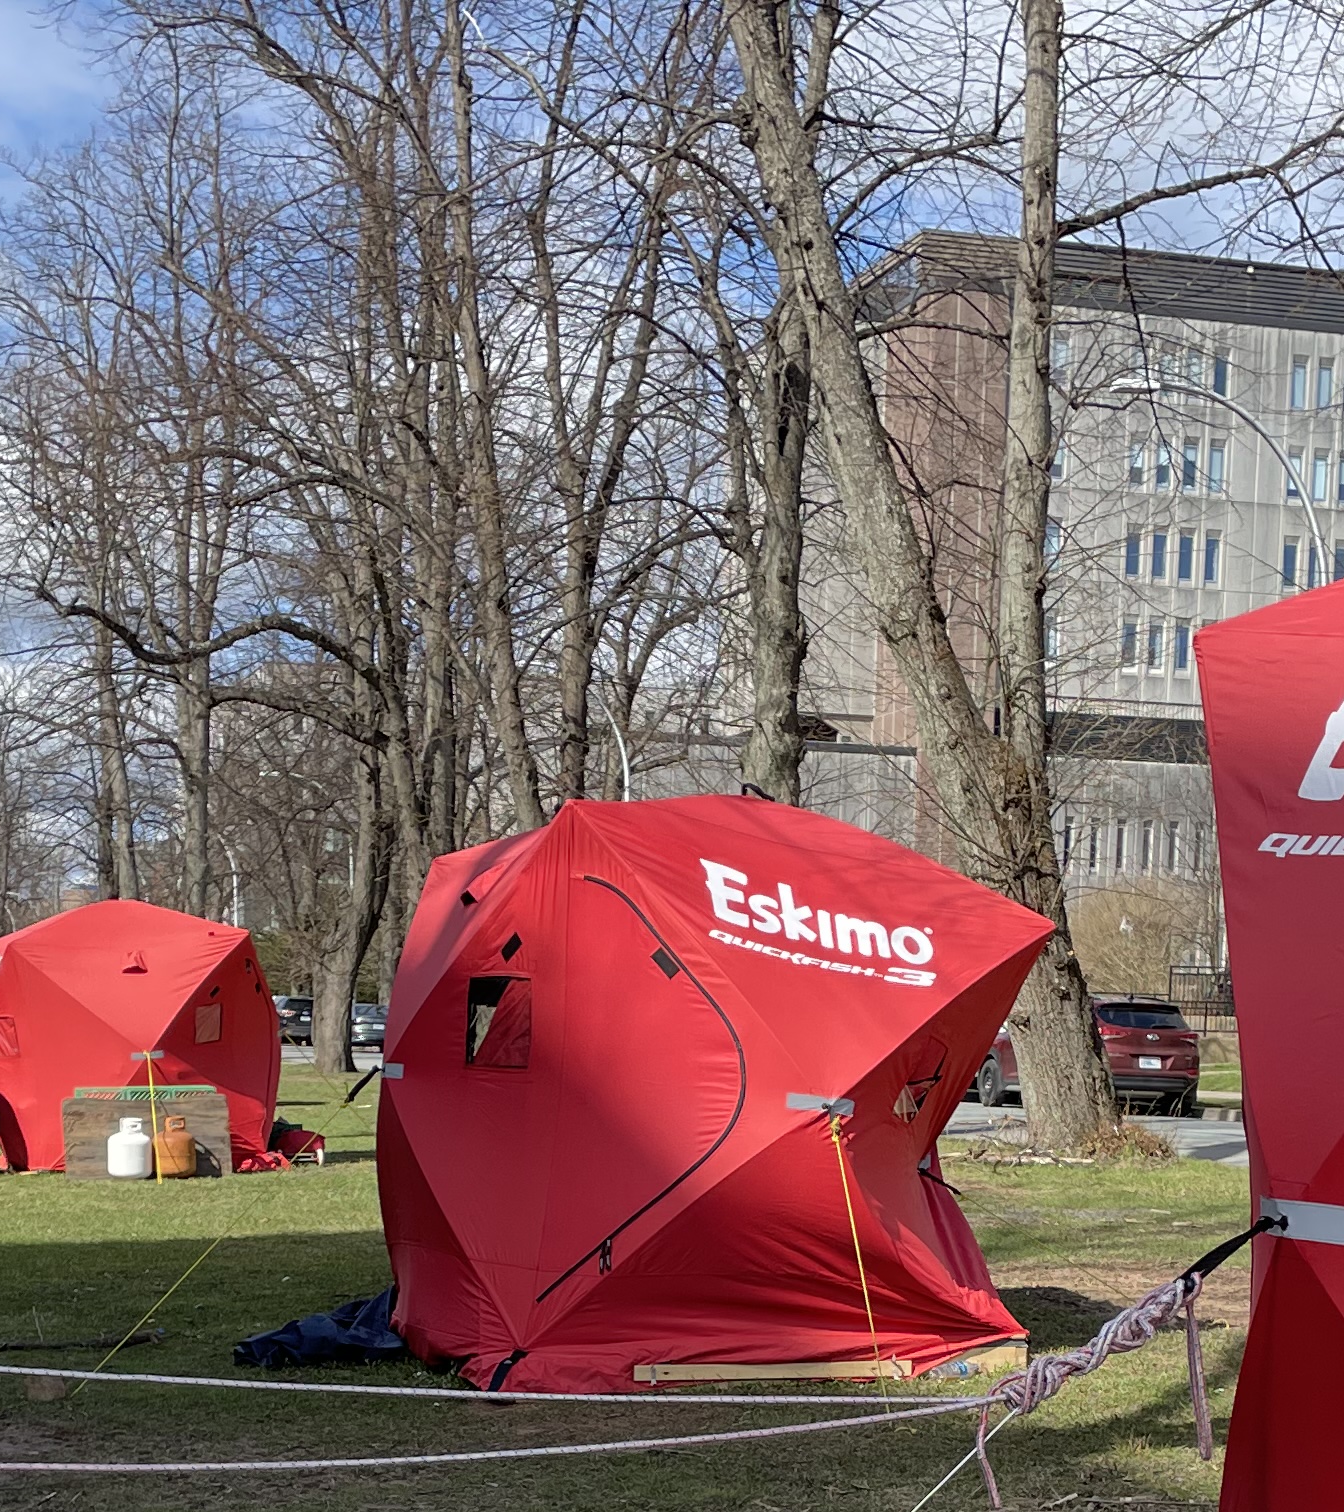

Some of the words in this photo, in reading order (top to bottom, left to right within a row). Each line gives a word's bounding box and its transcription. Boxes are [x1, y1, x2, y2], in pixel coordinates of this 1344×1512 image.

[699, 857, 934, 966] Eskimo
[708, 929, 876, 977] QUICKFISH
[883, 966, 938, 988] 3
